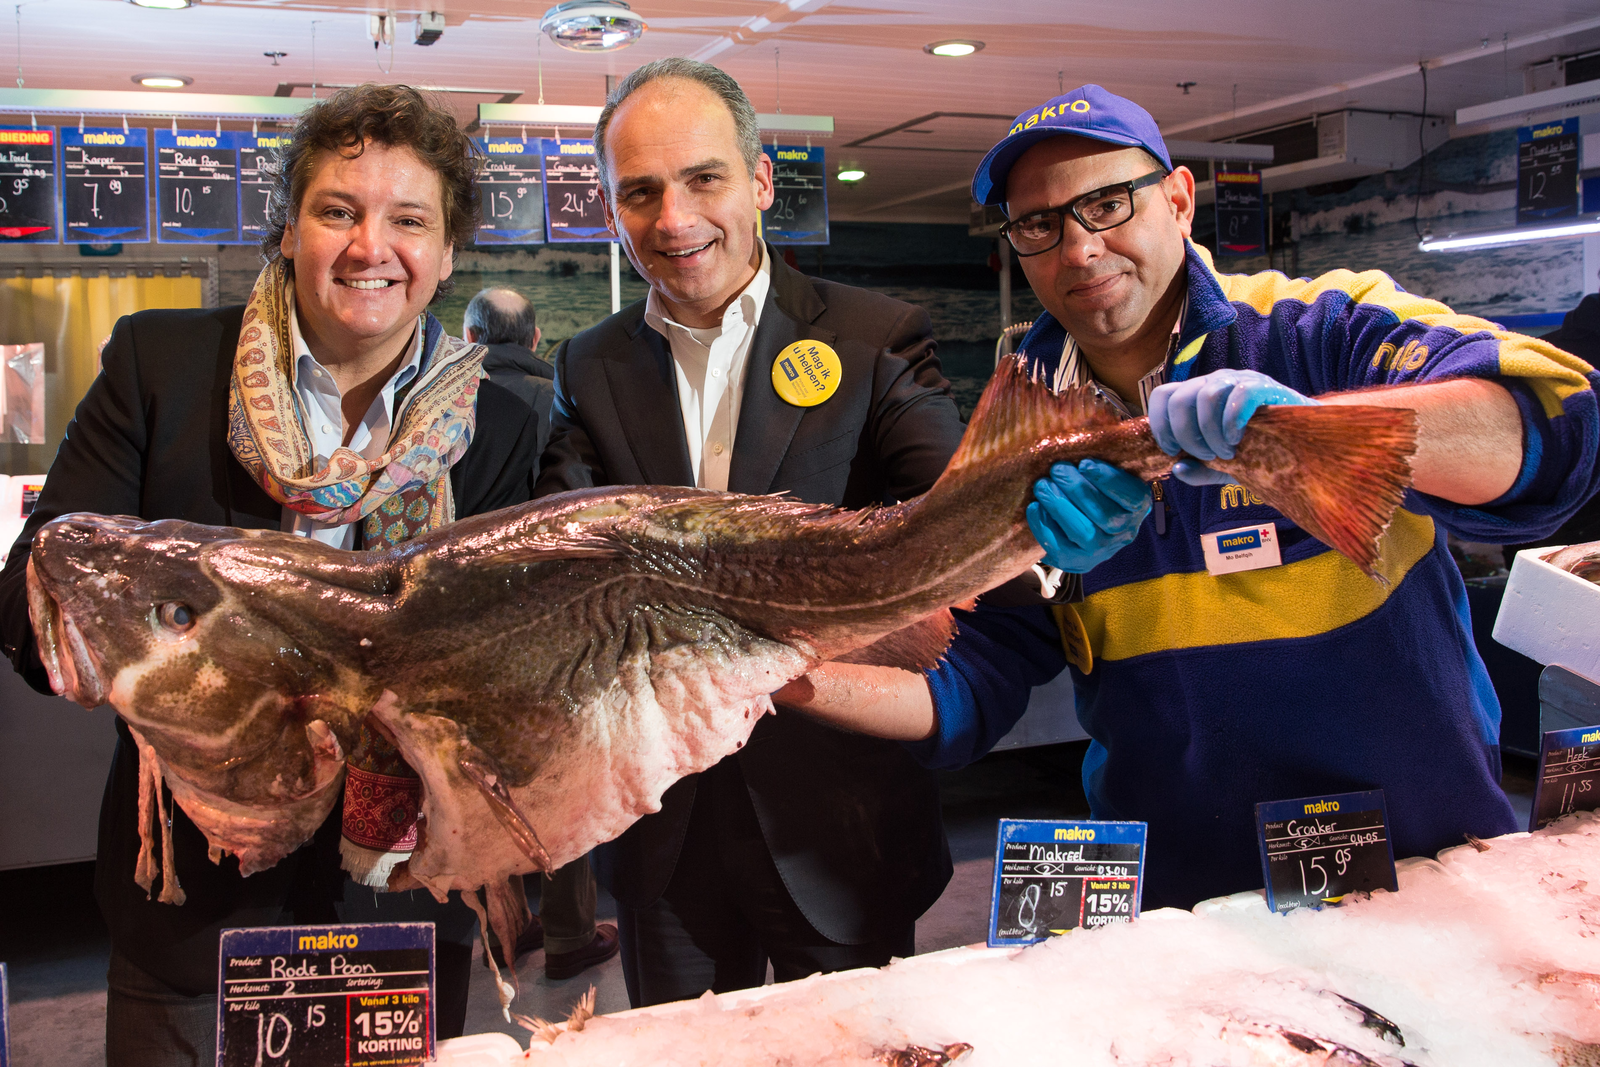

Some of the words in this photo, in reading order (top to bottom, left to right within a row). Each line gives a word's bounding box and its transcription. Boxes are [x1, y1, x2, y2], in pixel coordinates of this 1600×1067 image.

[1008, 99, 1091, 137] makro
[83, 132, 125, 145] makro
[1533, 125, 1564, 139] makro
[176, 134, 217, 148] makro
[488, 141, 524, 154] makro
[82, 150, 115, 167] Karper
[174, 152, 197, 166] Rode
[201, 155, 220, 168] Poon
[777, 150, 808, 161] makro
[484, 159, 517, 171] Croaker
[202, 186, 212, 194] 15
[793, 346, 801, 354] u
[797, 353, 826, 391] helpen?
[807, 346, 824, 370] Mag
[820, 368, 831, 380] ik
[1222, 535, 1255, 548] makro
[1566, 746, 1589, 763] Heek
[1304, 800, 1340, 815] makro
[1054, 825, 1096, 841] makro
[1265, 822, 1284, 830] Product
[1287, 818, 1337, 837] Croaker
[1268, 841, 1292, 850] Herkomst:
[1300, 839, 1308, 850] 5
[1004, 863, 1031, 871] Herkomst:
[1043, 865, 1051, 876] 2
[1335, 847, 1352, 876] 95
[1003, 877, 1012, 885] Per
[1090, 881, 1110, 890] Vanaf
[1111, 881, 1117, 890] 3
[1118, 881, 1131, 890] kilo
[1050, 881, 1068, 898] 15
[1086, 893, 1129, 914] 15%
[1086, 915, 1130, 927] KORTING
[299, 931, 359, 951] makro
[229, 957, 263, 967] Product
[270, 956, 319, 979] Rode
[330, 954, 376, 977] Poon
[229, 984, 271, 994] Herkomst:
[282, 981, 296, 997] 2
[345, 977, 384, 990] Sortering:
[229, 1003, 243, 1012] Per
[244, 1001, 261, 1011] kilo
[360, 995, 389, 1007] Vanaf
[392, 995, 400, 1005] 3
[402, 994, 420, 1005] kilo
[304, 1004, 327, 1031] 15
[354, 1009, 421, 1038] 15%
[358, 1037, 423, 1055] KORTING
